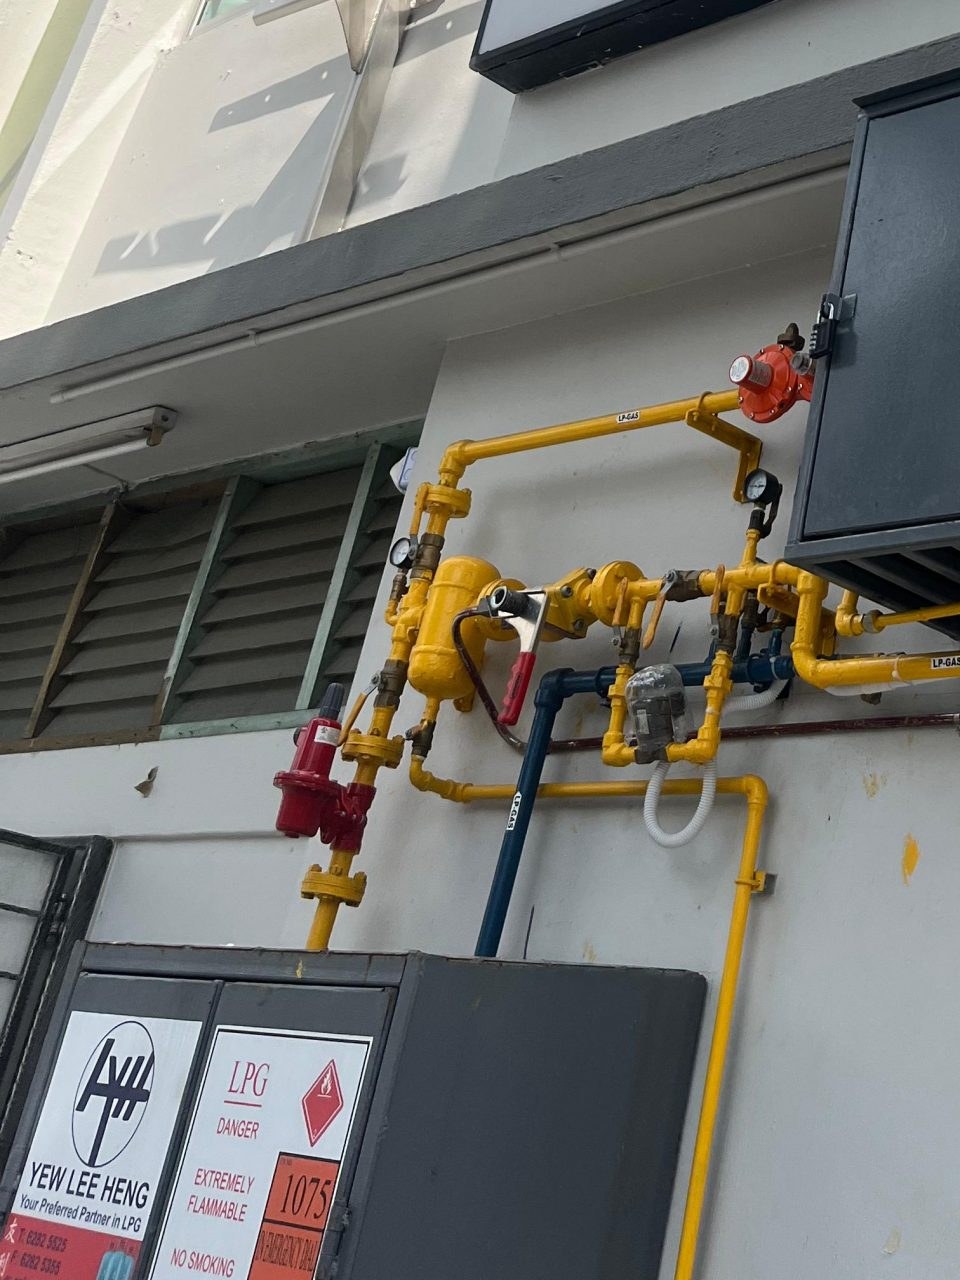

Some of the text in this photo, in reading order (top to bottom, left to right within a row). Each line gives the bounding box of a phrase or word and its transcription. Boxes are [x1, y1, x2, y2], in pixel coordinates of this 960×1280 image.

[508, 795, 521, 829] LP-GAS
[227, 1060, 270, 1097] LPG
[216, 1117, 259, 1140] DANGER
[29, 1162, 150, 1209] YEW LEE HENG
[194, 1168, 255, 1195] EXTREMELY
[280, 1174, 332, 1219] 1075
[20, 1193, 142, 1233] Your Preferred Partner in LPG
[187, 1195, 247, 1222] FLAMMABLE
[170, 1248, 235, 1278] NO SMOKING
